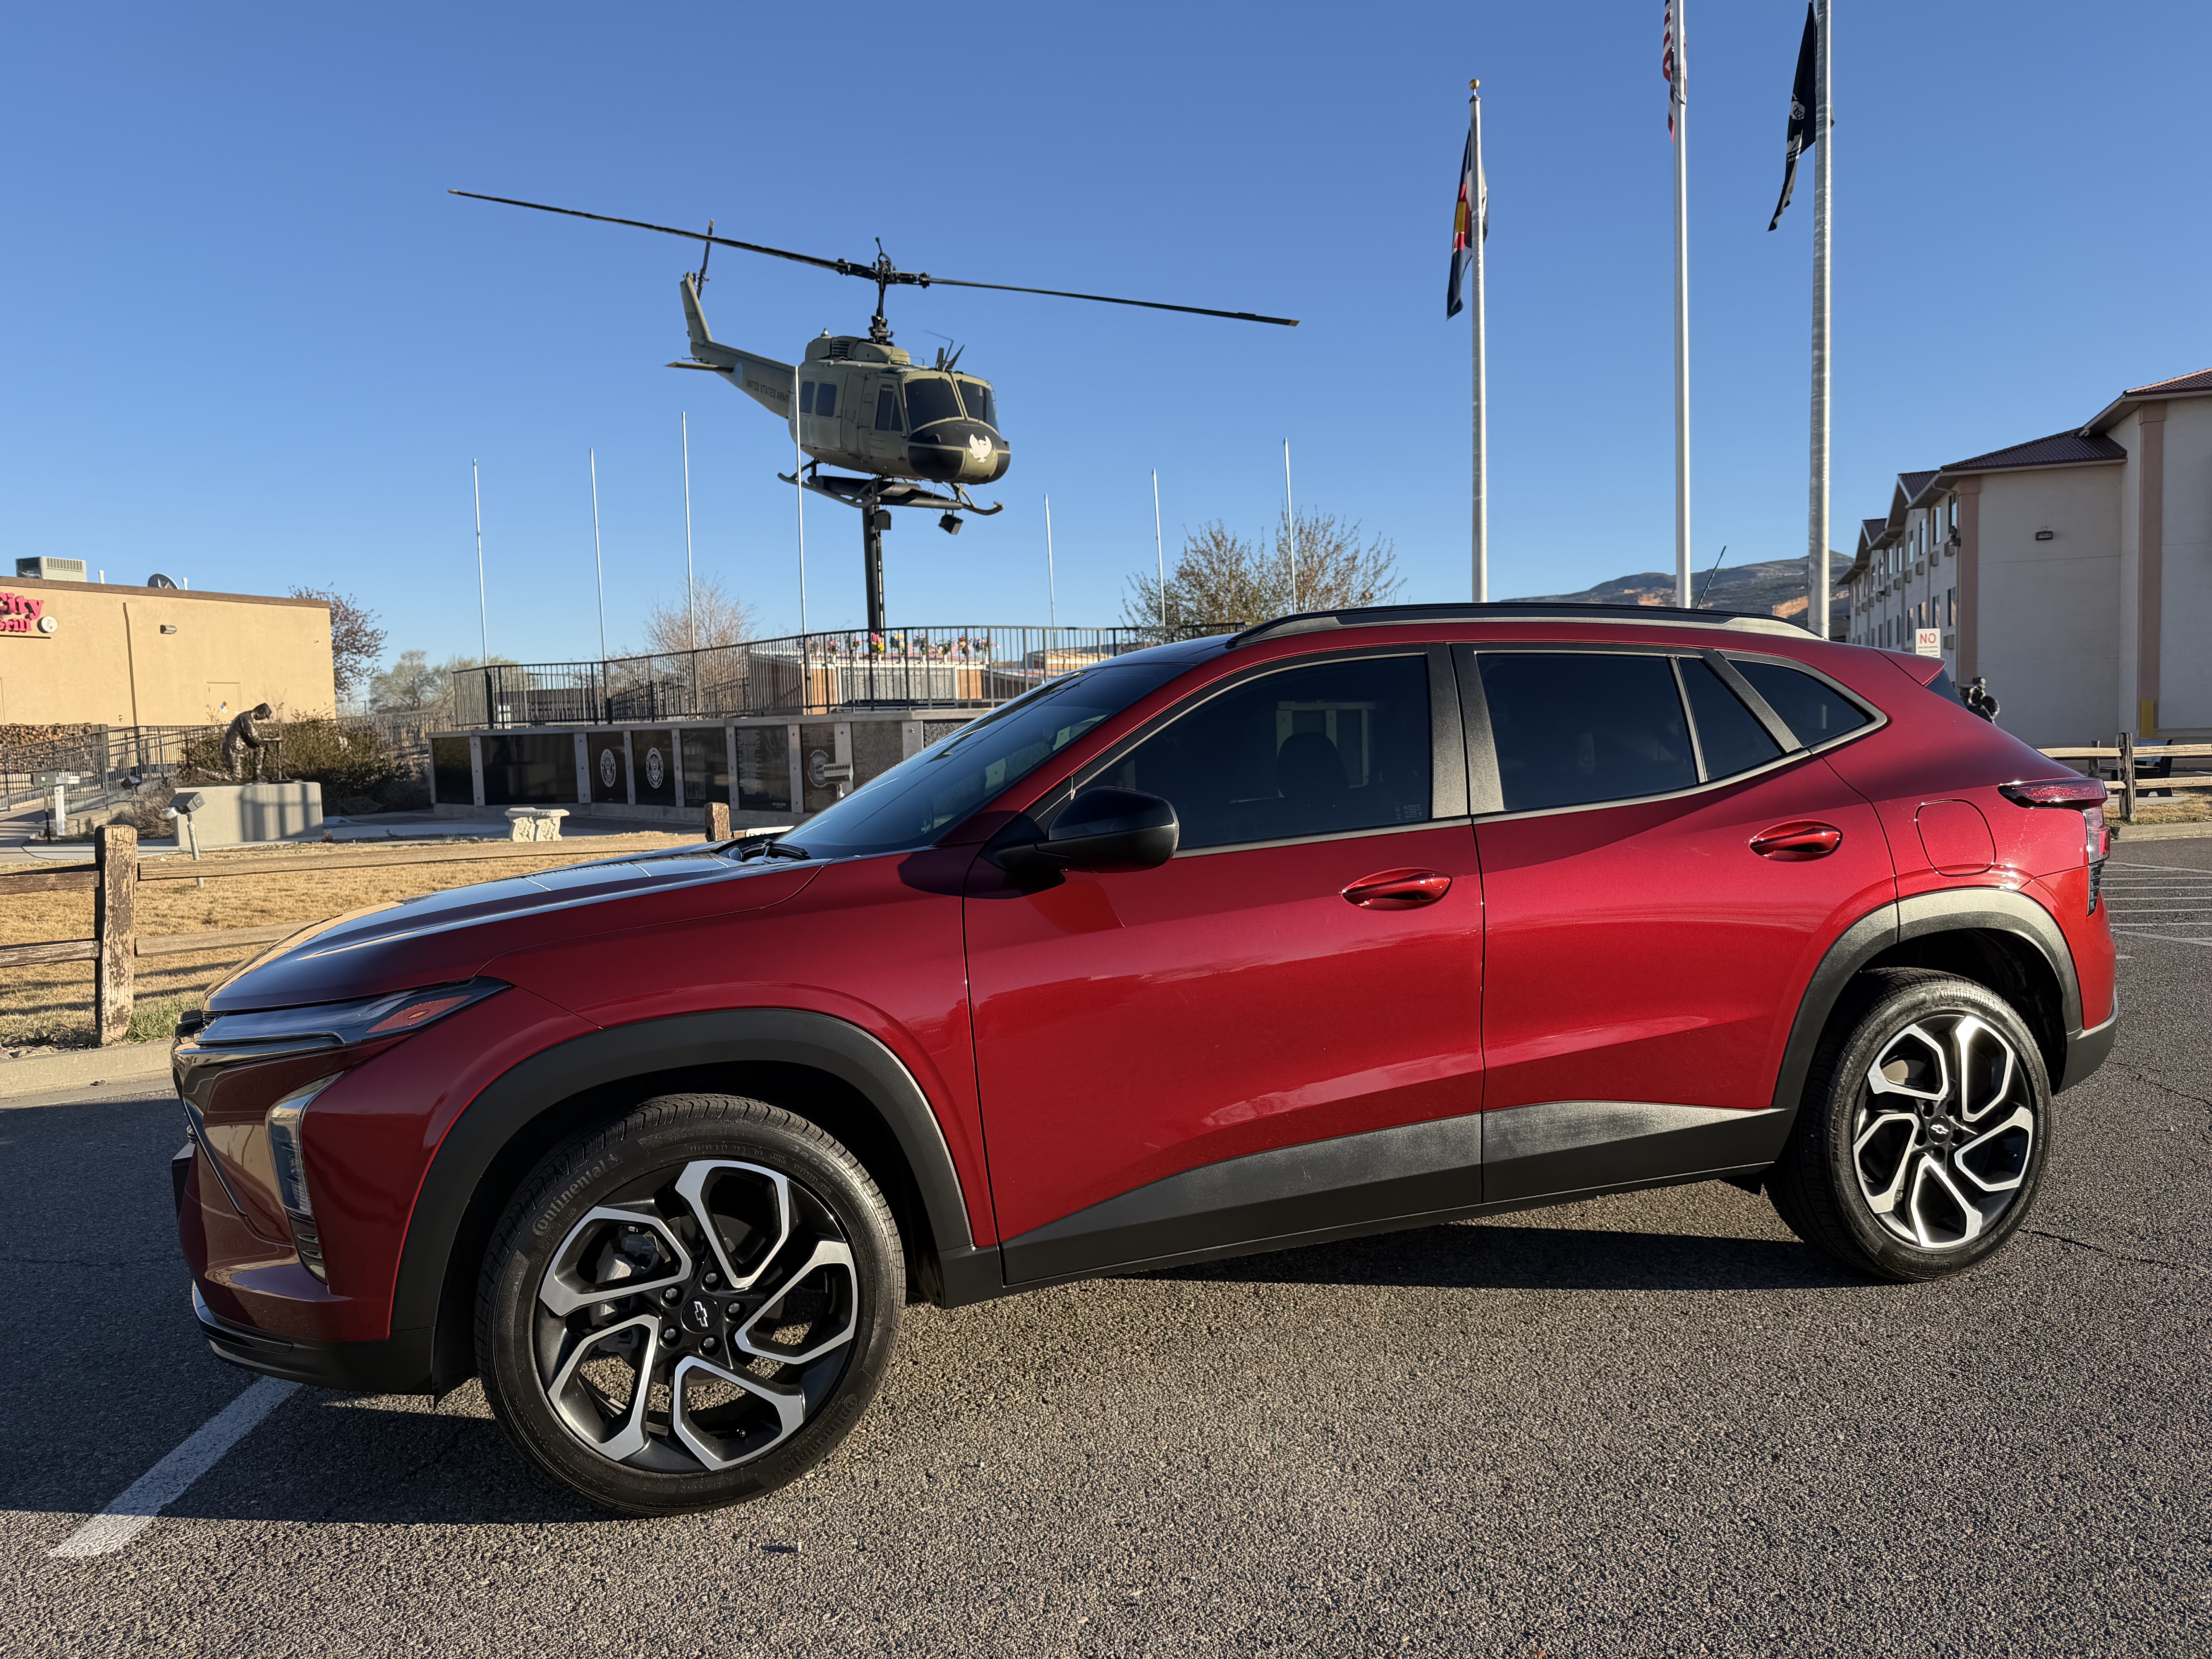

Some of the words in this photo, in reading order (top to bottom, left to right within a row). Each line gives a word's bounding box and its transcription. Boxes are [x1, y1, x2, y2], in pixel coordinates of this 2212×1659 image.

[746, 379, 759, 392] UNITED
[761, 384, 776, 398] STATES
[1920, 633, 1936, 644] NO
[532, 1159, 607, 1236] Continental
